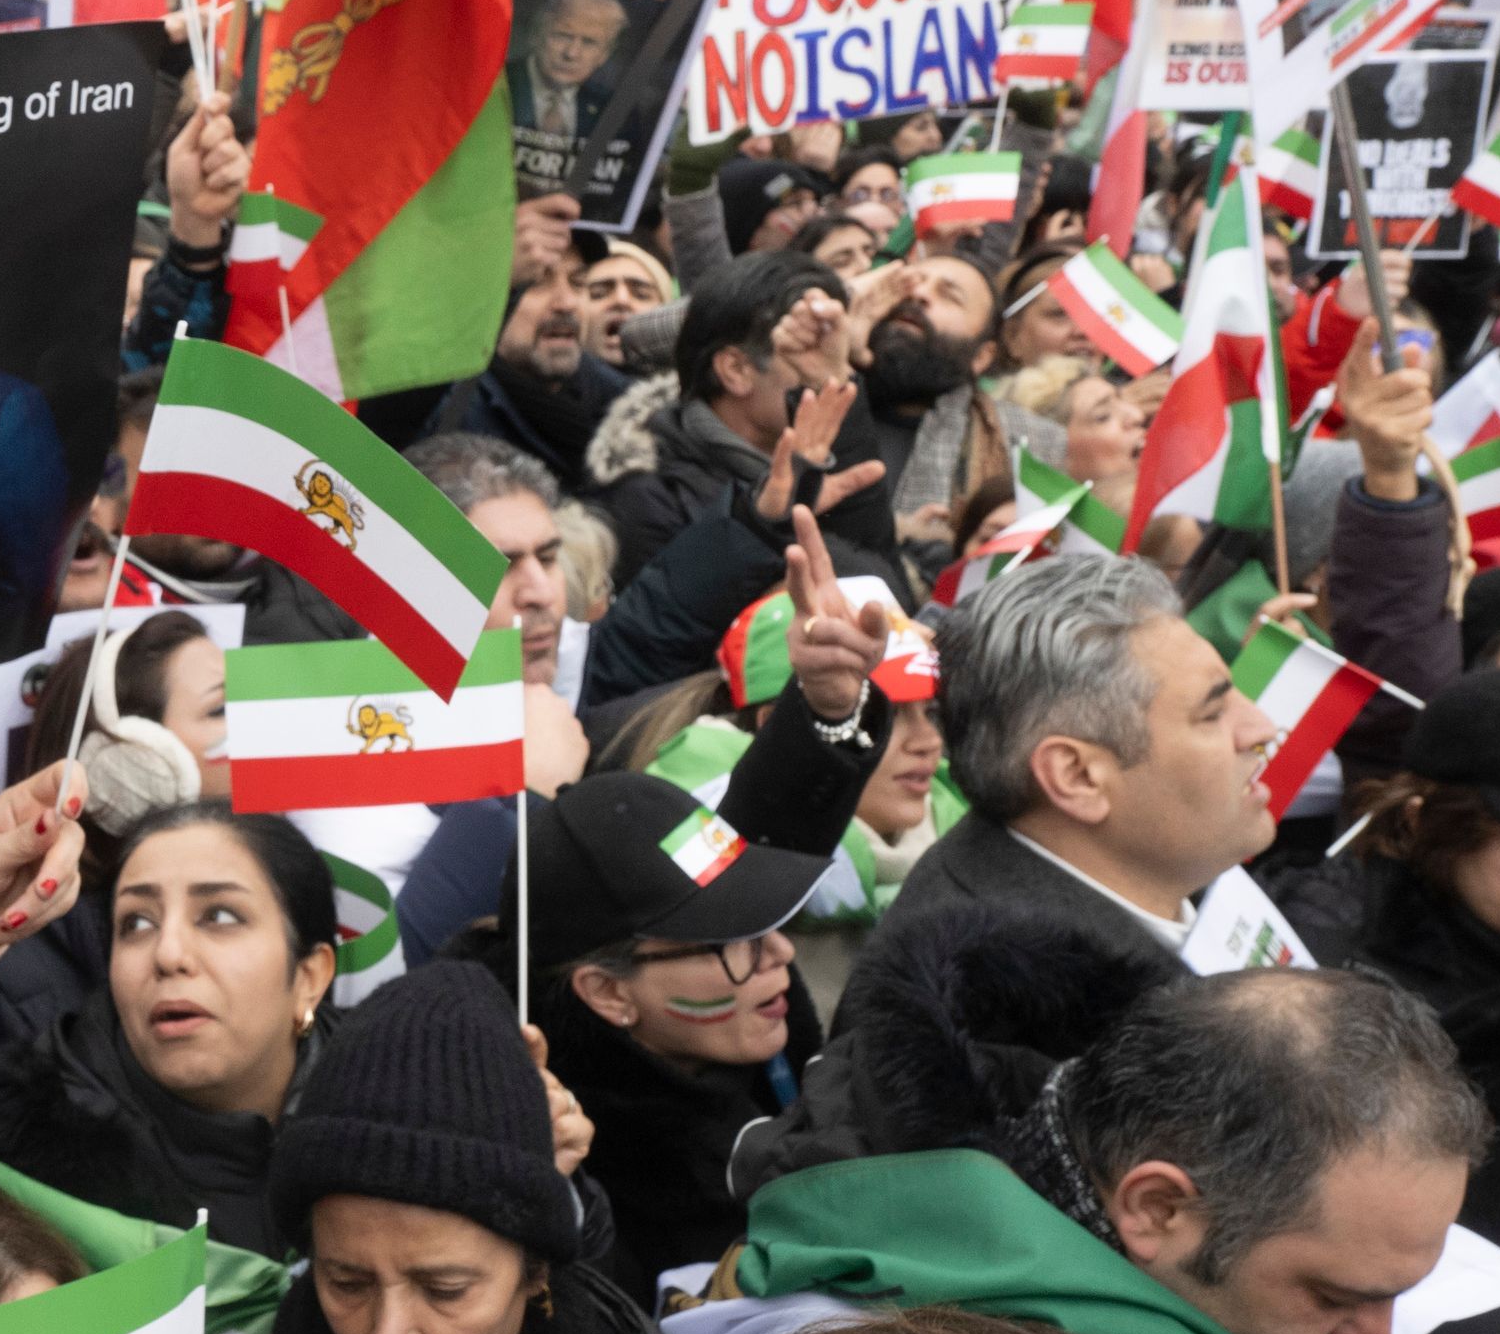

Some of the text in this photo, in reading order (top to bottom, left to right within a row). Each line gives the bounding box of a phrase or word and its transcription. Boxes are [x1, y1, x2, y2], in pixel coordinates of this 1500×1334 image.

[24, 81, 63, 120] of
[69, 79, 135, 116] Iran
[704, 30, 796, 132] NO
